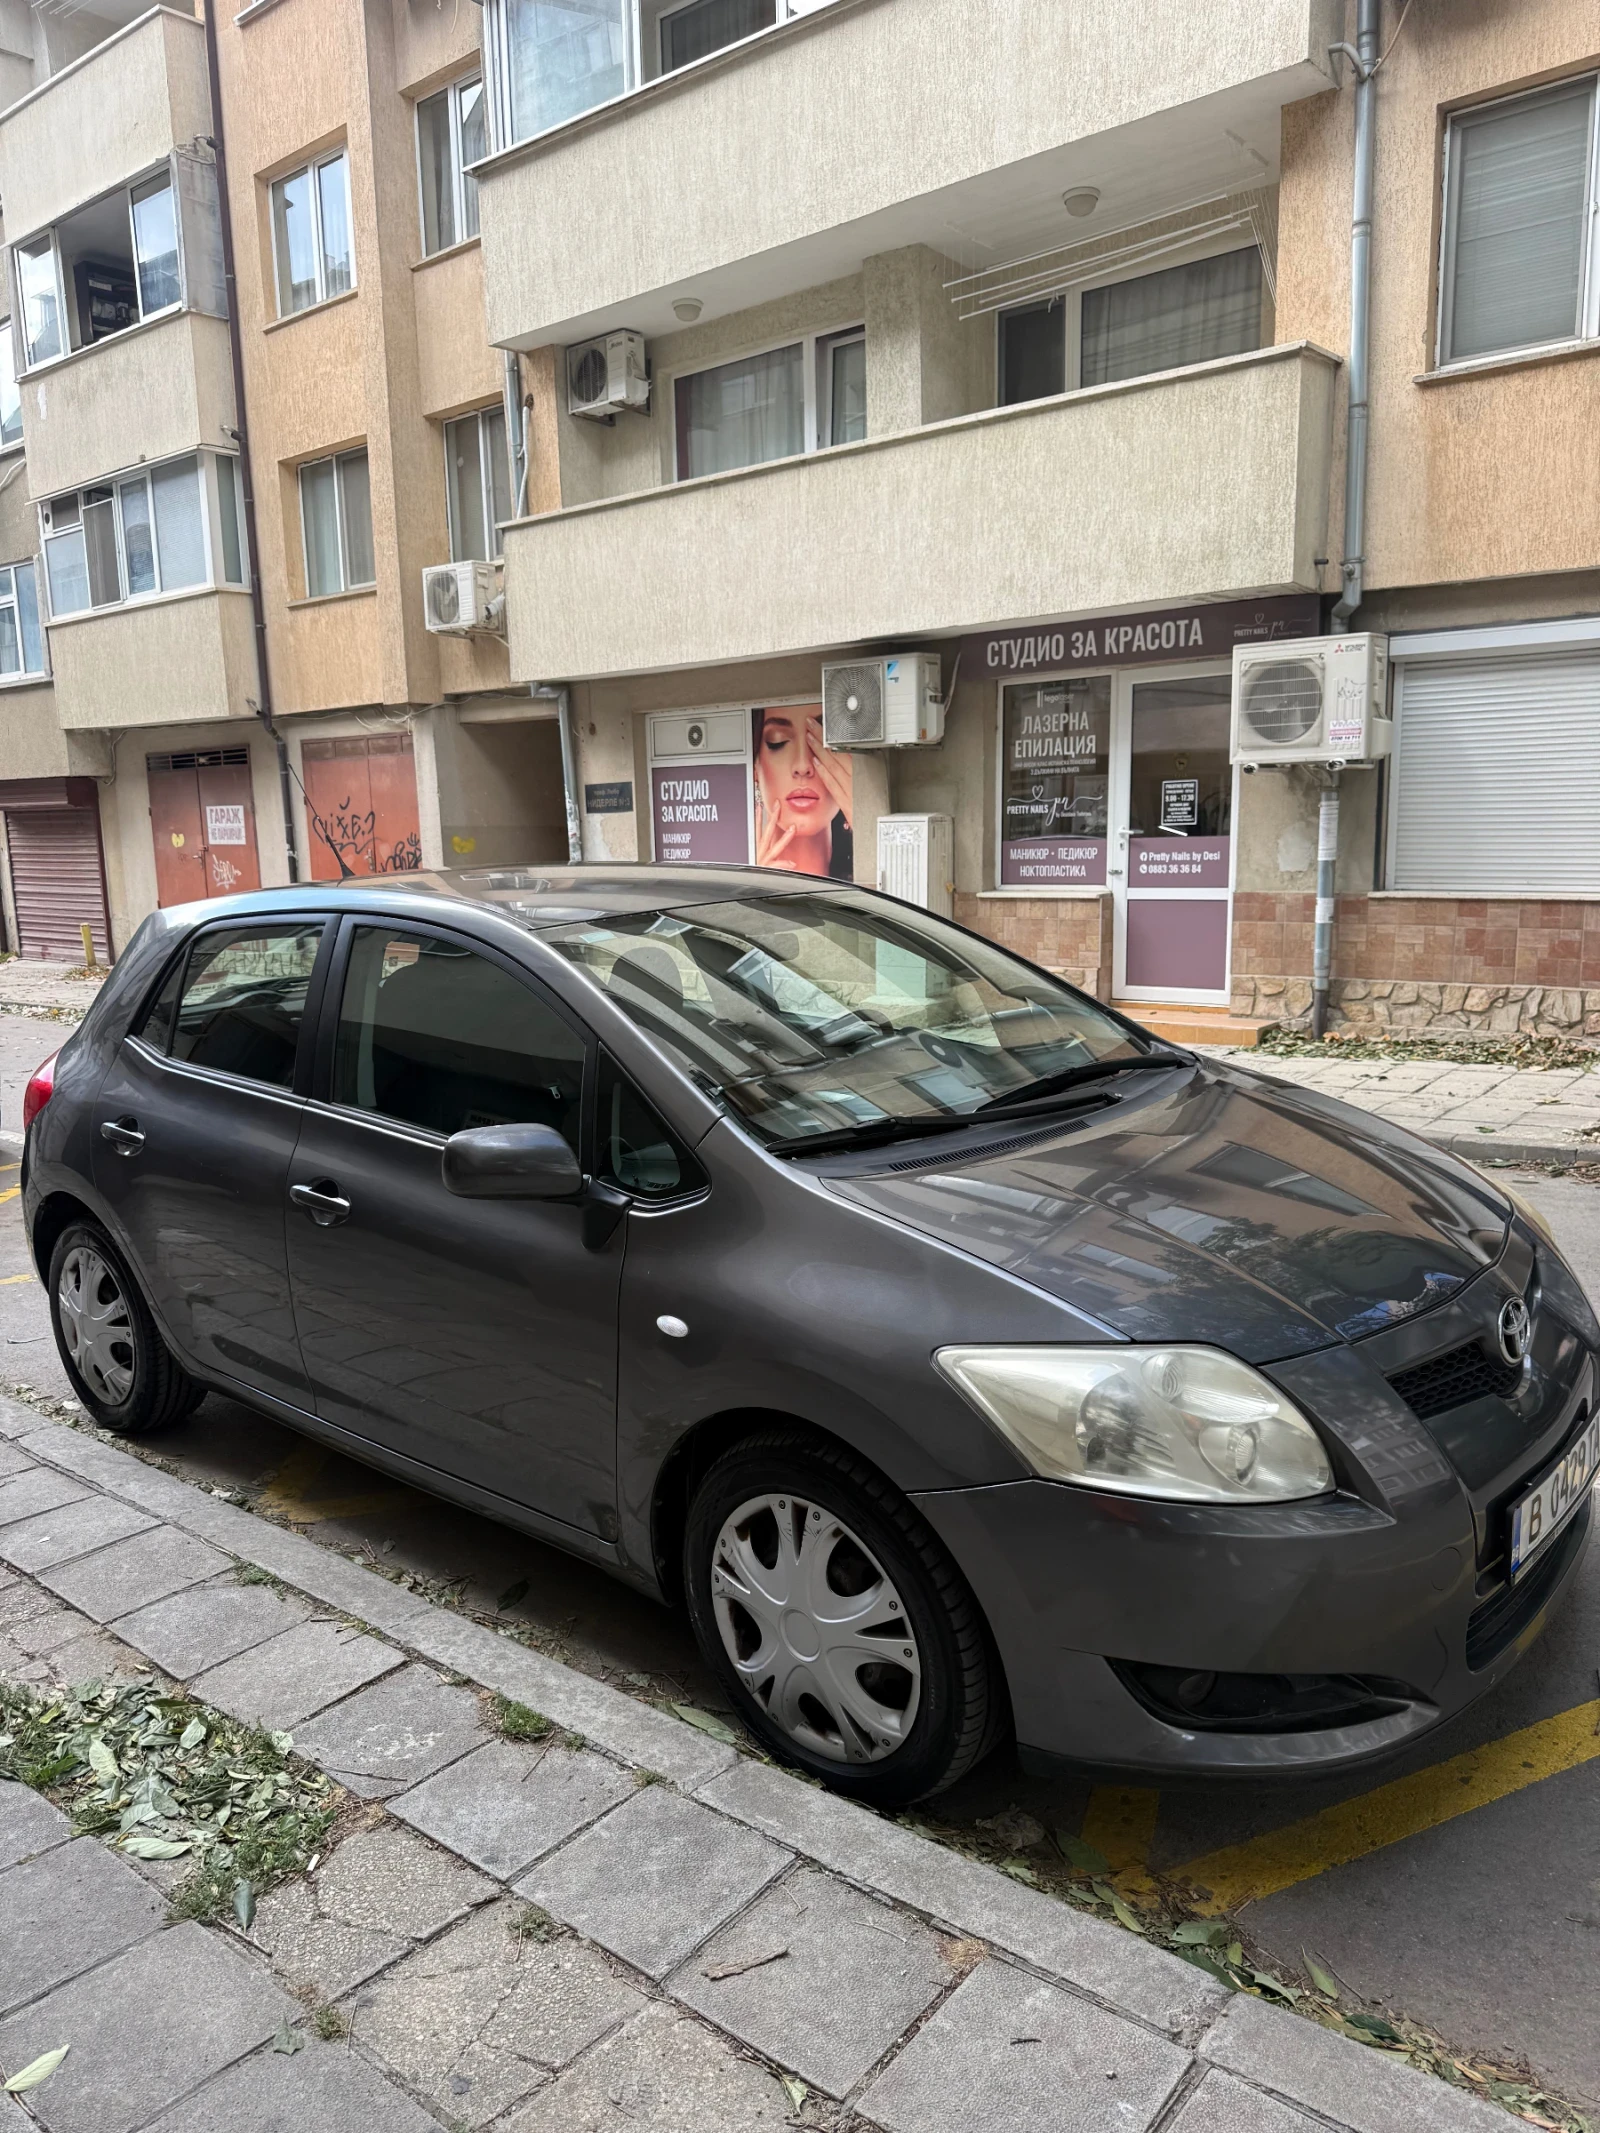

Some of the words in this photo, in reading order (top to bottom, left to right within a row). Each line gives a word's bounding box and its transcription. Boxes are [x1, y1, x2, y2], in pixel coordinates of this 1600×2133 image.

[986, 634, 1065, 668] СТУДИО
[1071, 631, 1097, 659] ЗА
[1104, 618, 1204, 655] КРАСОТА
[1021, 711, 1089, 735] ЛАЗЕРНА
[1015, 734, 1096, 758] ЕПИЛАЦИЯ
[660, 779, 709, 803] СТУДИО
[209, 808, 242, 824] ГАРАЖ
[661, 805, 674, 823] ЗА
[675, 804, 719, 822] КРАСОТА
[1006, 805, 1029, 815] PRETTY
[1030, 804, 1049, 814] NAILS
[662, 833, 692, 844] МАНИКЮР
[663, 848, 691, 860] ПЕДИКЮР
[1009, 848, 1050, 860] МАНИКЮР
[1058, 847, 1098, 861] ПЕДИКЮР
[1149, 852, 1170, 863] Pretty
[1171, 851, 1191, 861] Nails
[1192, 851, 1202, 862] by
[1203, 851, 1220, 861] Desi
[1020, 865, 1087, 877] НОКТОПЛАСТИКА
[1148, 864, 1167, 874] 0883
[1168, 864, 1178, 874] 36
[1180, 864, 1190, 874] 36
[1191, 864, 1202, 874] 84
